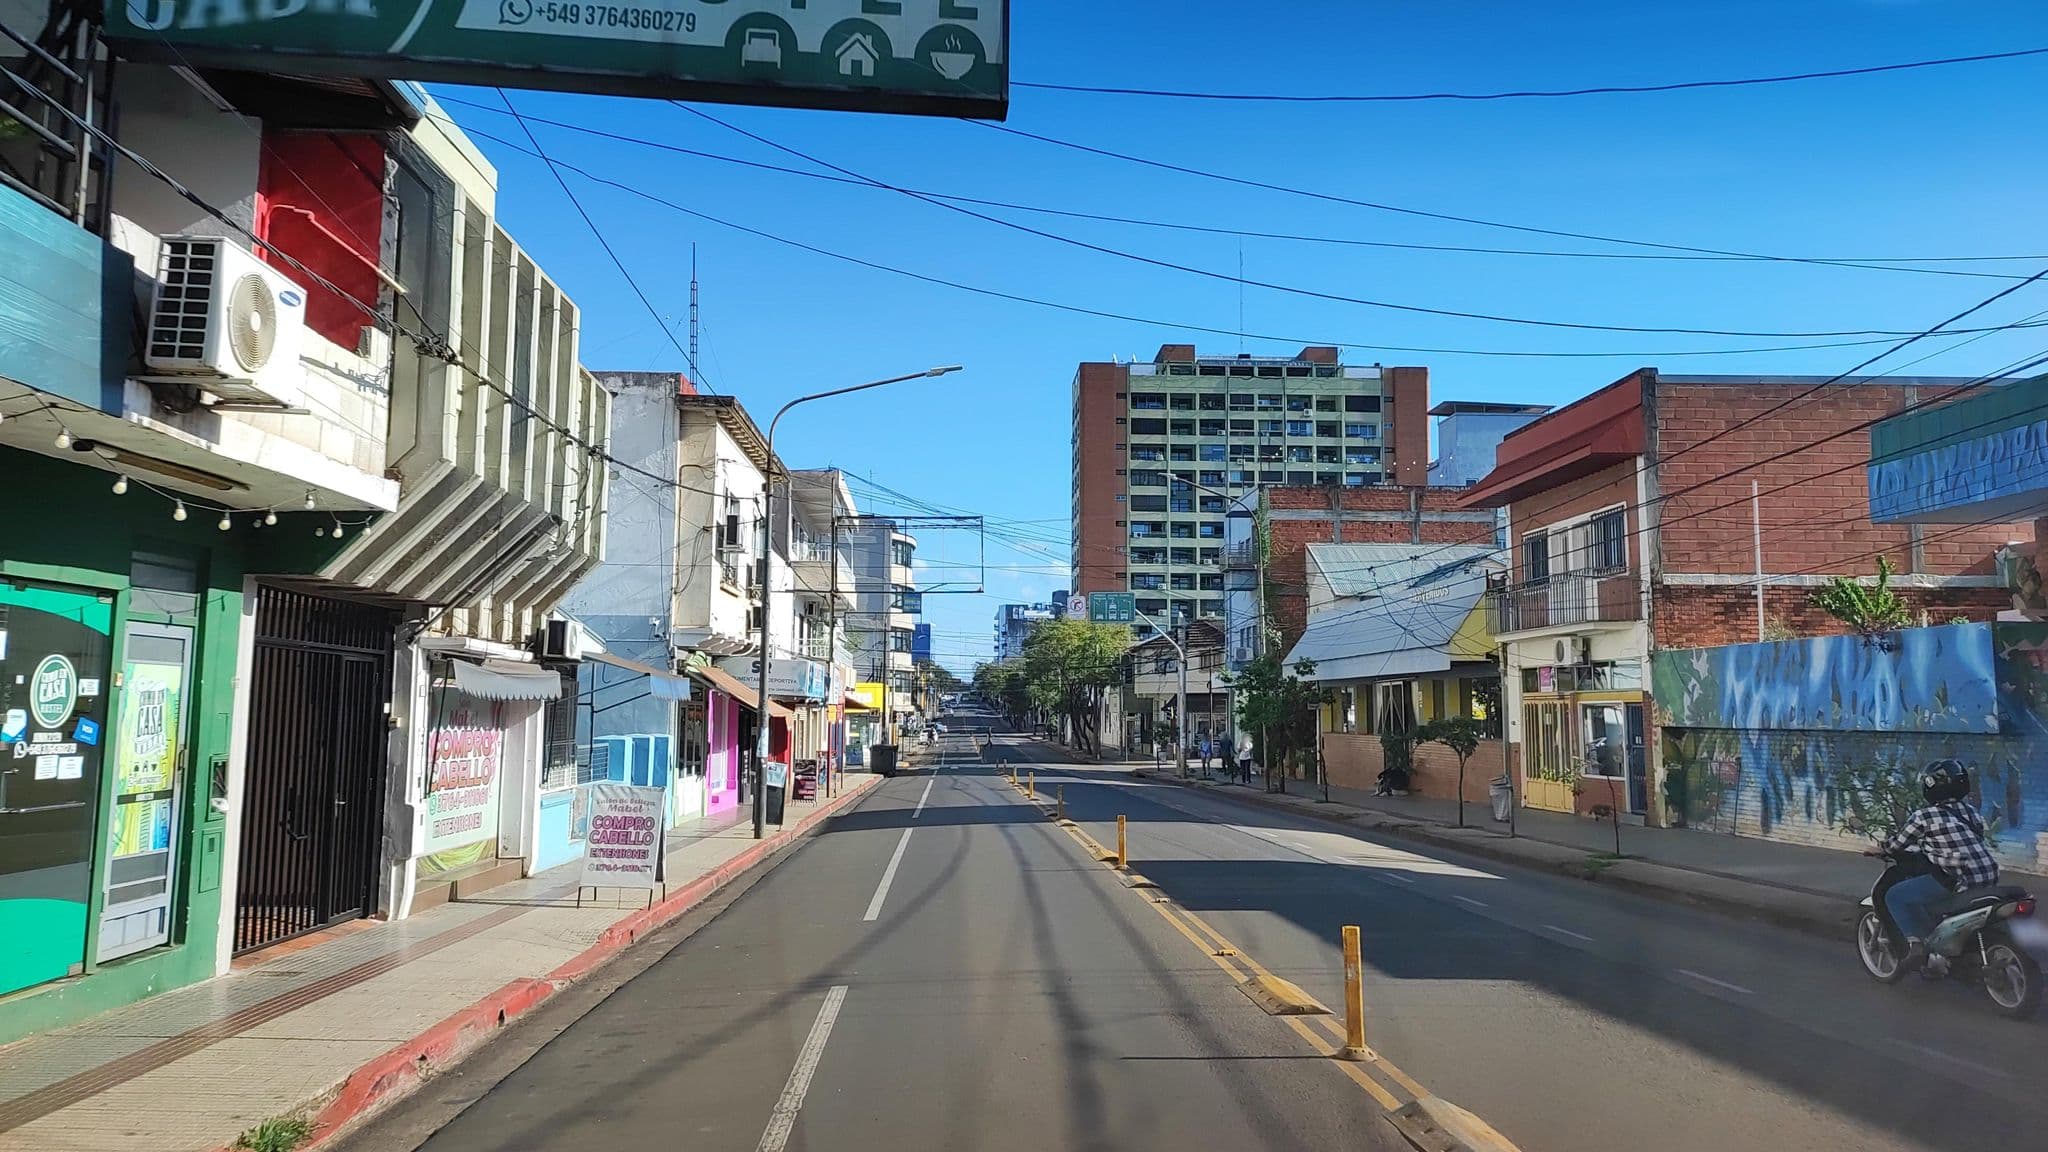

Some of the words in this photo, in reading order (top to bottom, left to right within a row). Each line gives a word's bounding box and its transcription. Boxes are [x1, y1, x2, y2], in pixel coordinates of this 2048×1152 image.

[535, 2, 581, 24] +549
[585, 5, 697, 33] 3764360279
[429, 728, 492, 762] COMPRO
[428, 758, 491, 793] CABELLO
[589, 830, 655, 846] CABELLO
[592, 815, 655, 831] COMPRO
